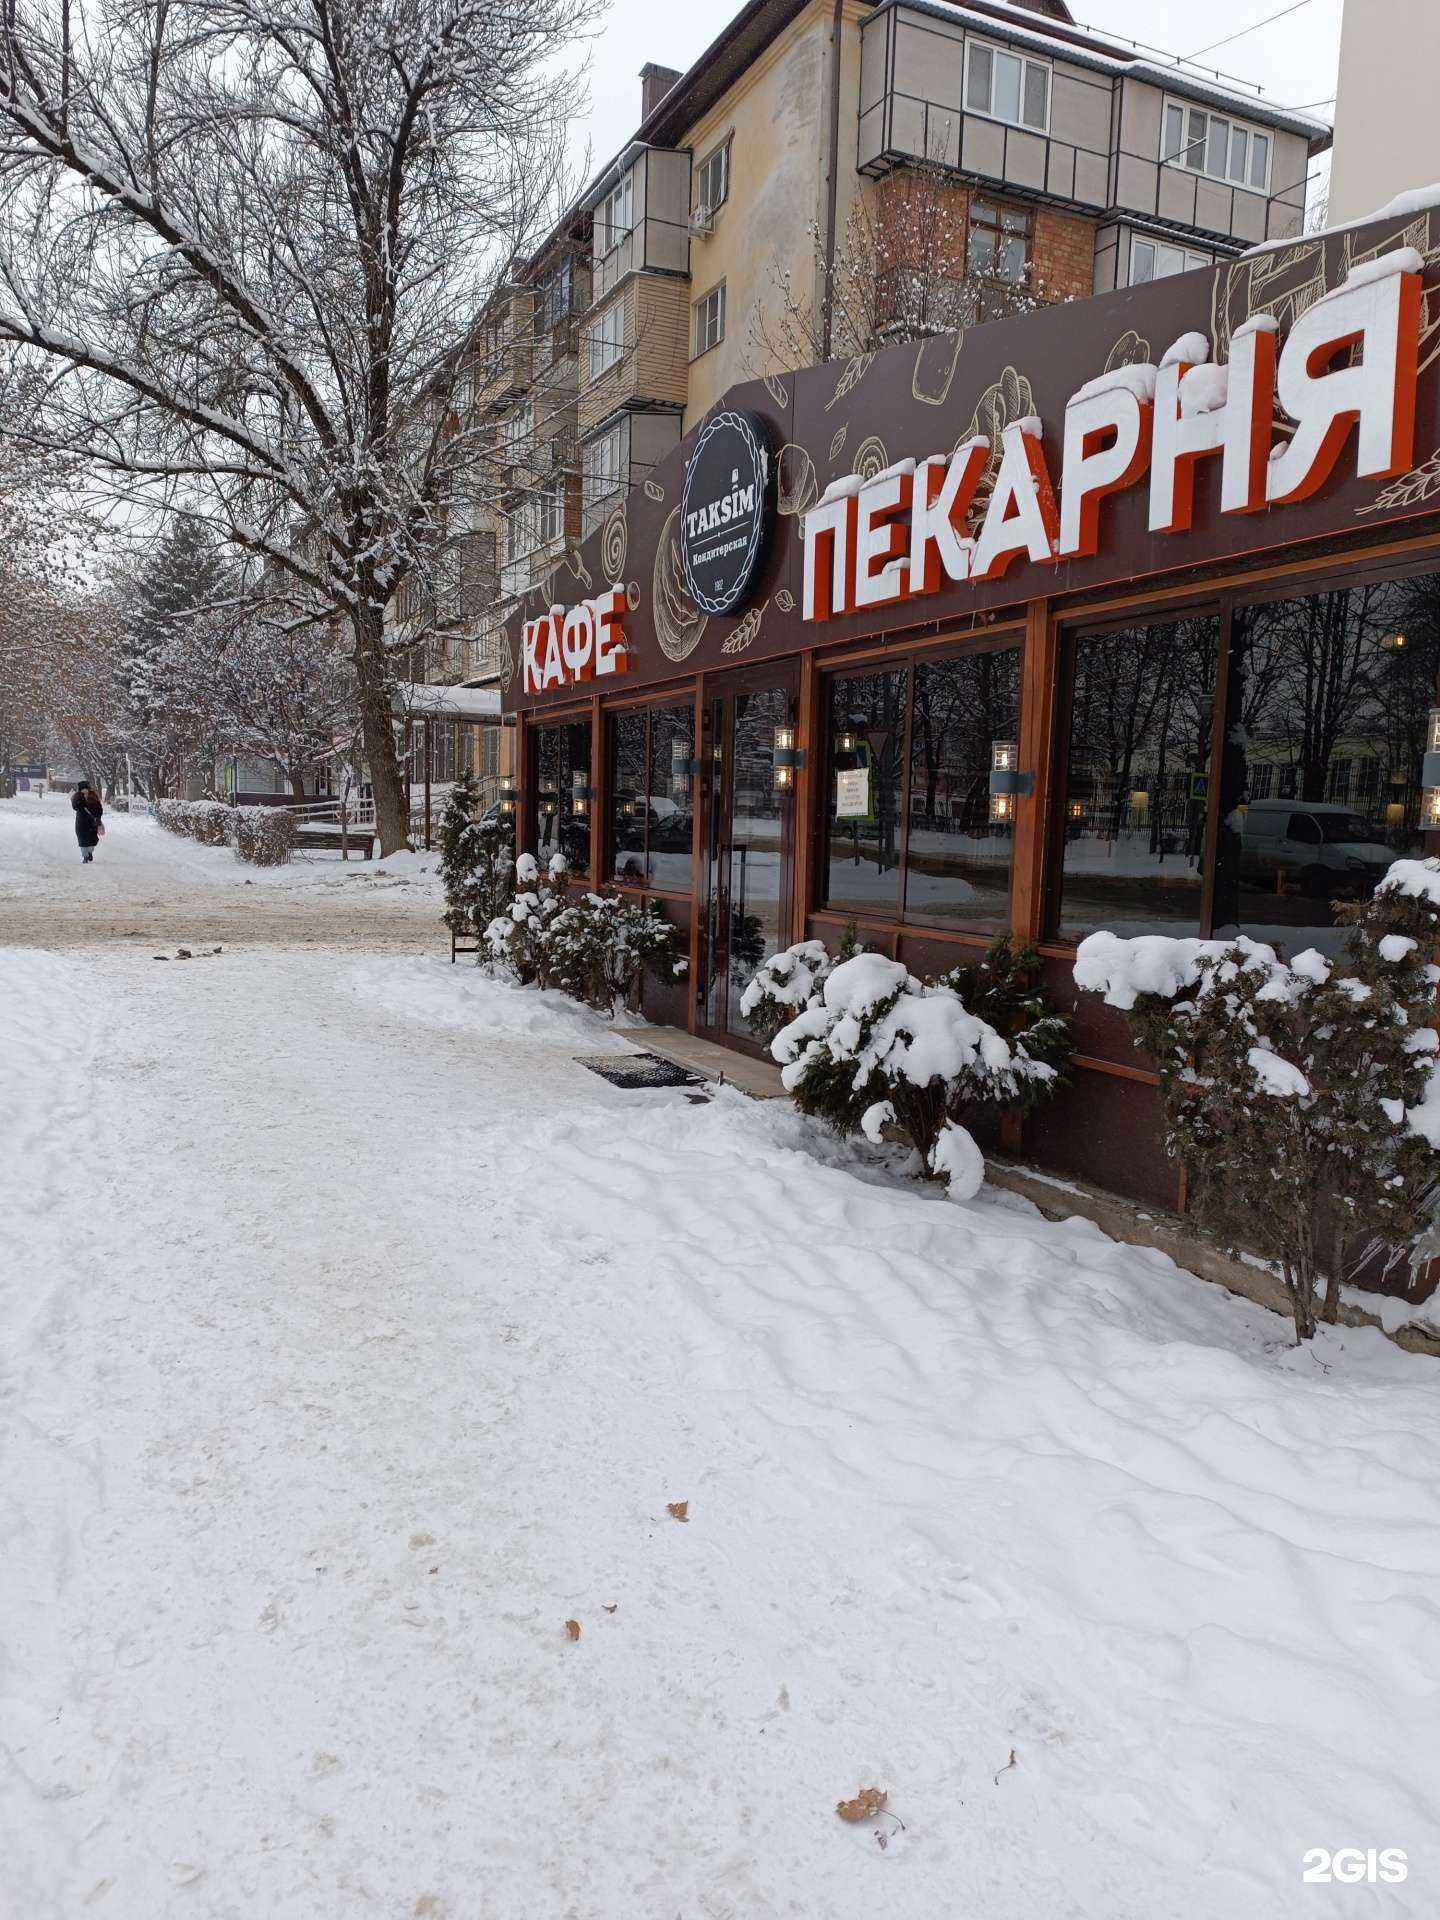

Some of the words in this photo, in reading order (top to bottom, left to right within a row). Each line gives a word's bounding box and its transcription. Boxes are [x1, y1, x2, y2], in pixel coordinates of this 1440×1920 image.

[803, 264, 1421, 623] ПЕКАРНЯ
[692, 535, 748, 566] Кондитерская
[523, 588, 626, 695] КАФЕ
